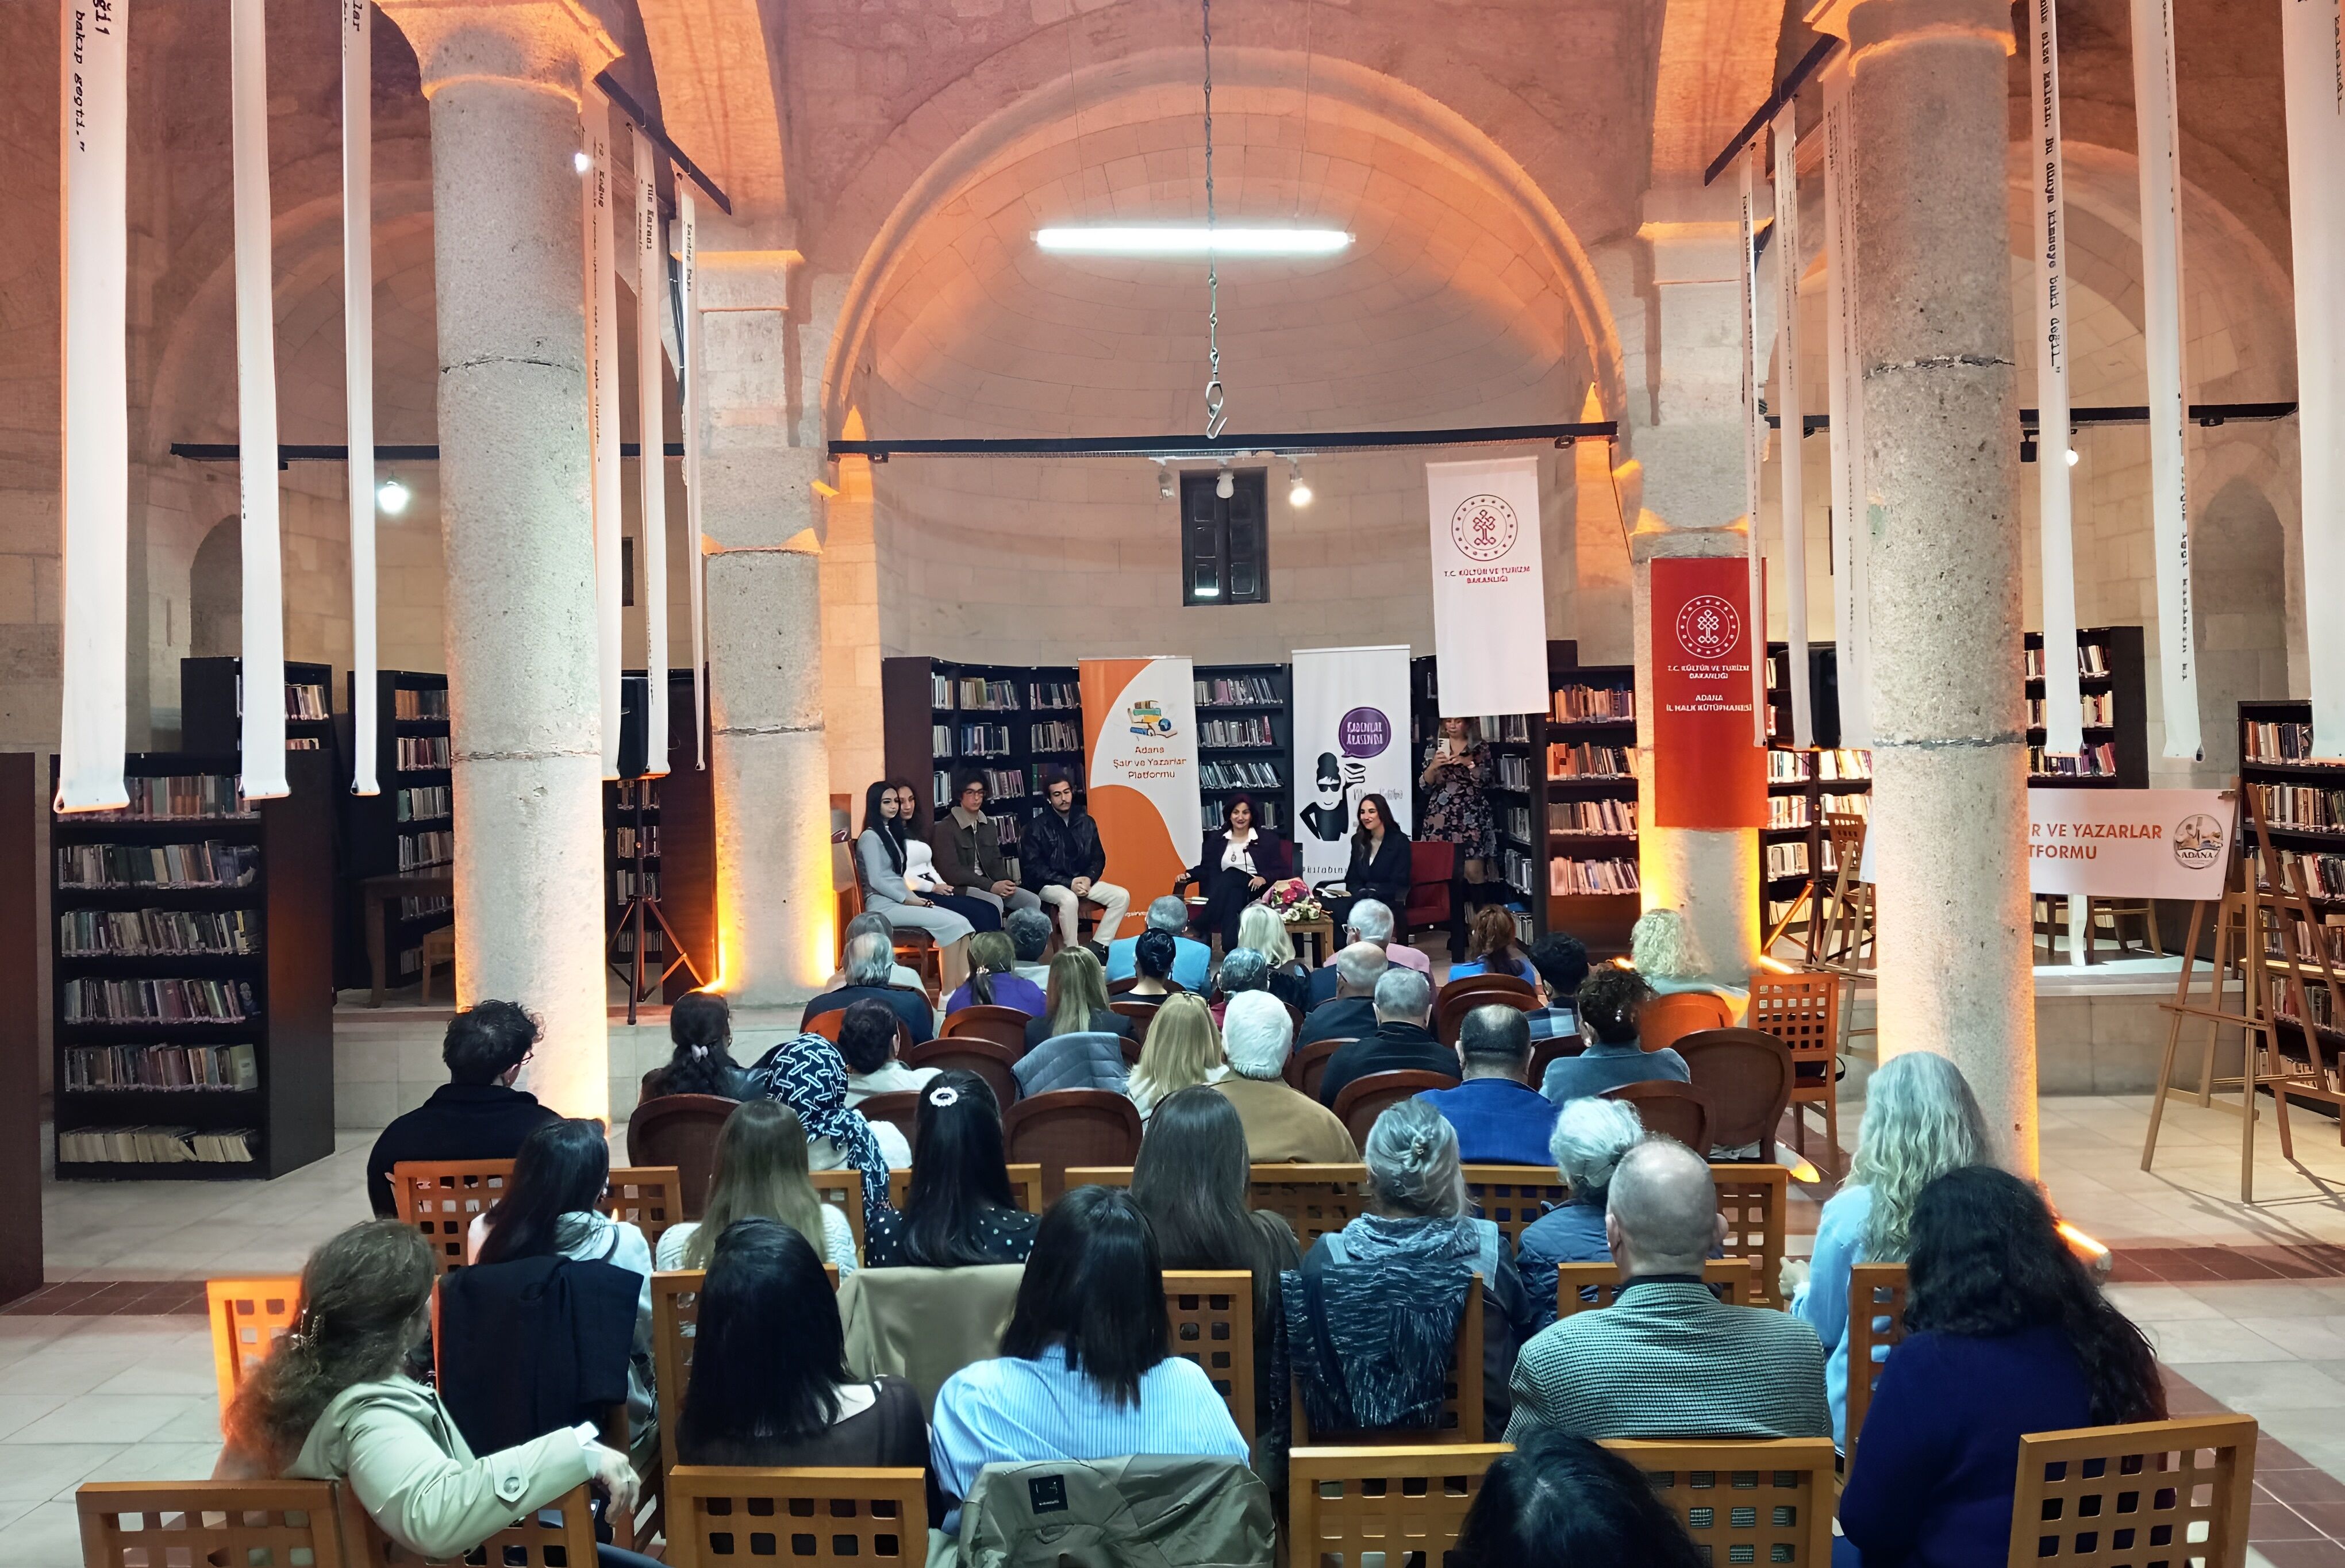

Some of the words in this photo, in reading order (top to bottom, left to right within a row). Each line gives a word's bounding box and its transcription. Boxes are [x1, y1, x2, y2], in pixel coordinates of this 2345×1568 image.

[1148, 758, 1186, 766] Yazarlar
[1128, 771, 1175, 779] Platformu
[2047, 823, 2067, 837] VE
[2073, 823, 2163, 839] YAZARLAR
